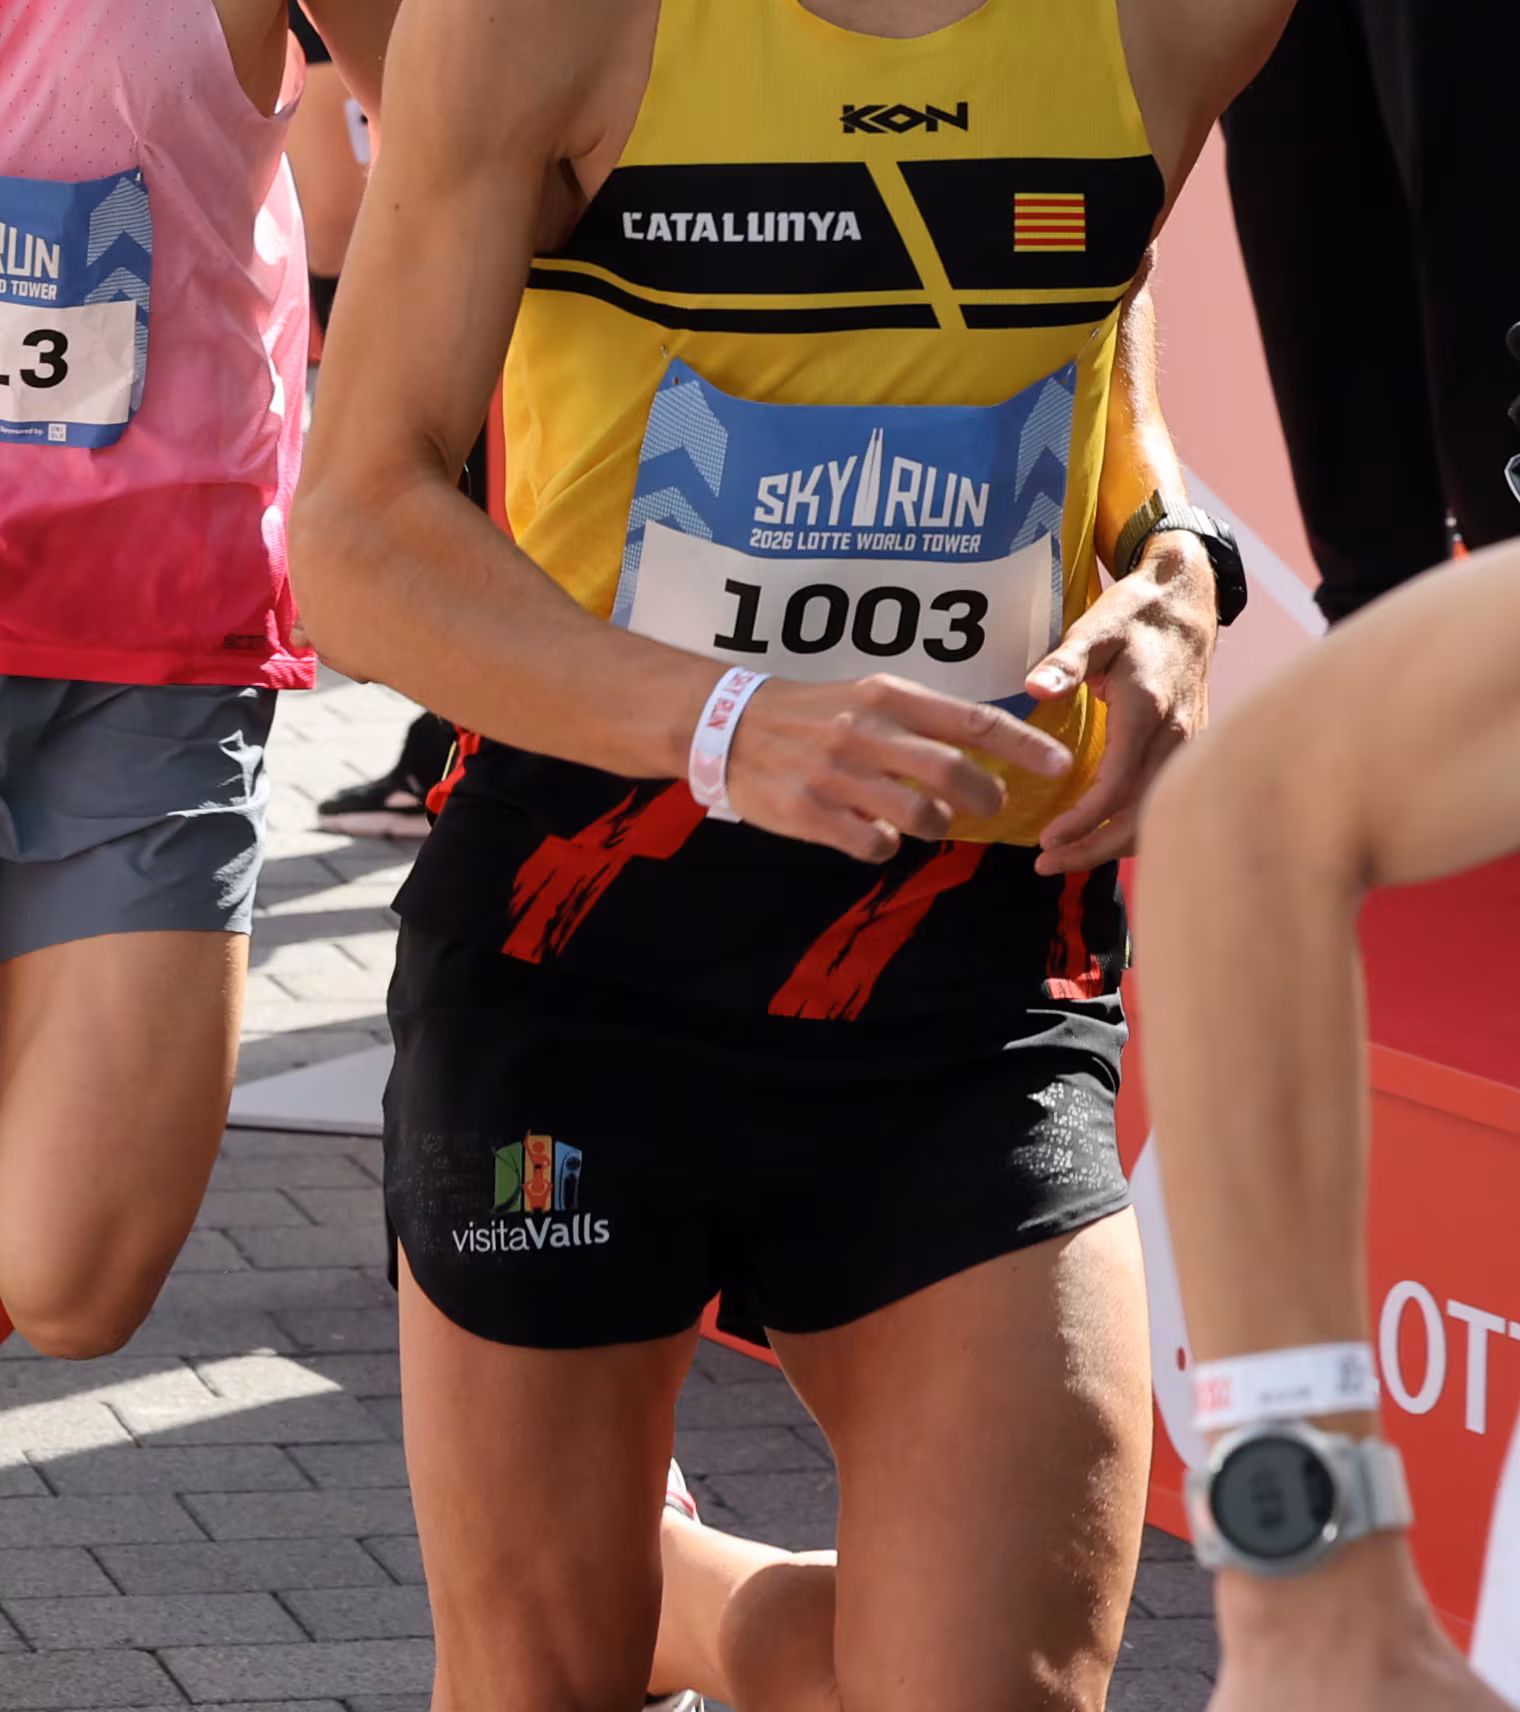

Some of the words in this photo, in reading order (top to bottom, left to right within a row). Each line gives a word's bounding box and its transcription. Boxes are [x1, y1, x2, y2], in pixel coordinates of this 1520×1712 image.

[840, 101, 969, 134] KON
[10, 279, 58, 300] TOWER
[753, 455, 858, 527] SKY
[883, 456, 990, 528] RUN
[749, 527, 793, 550] 2026
[797, 531, 852, 551] LOTTE
[856, 532, 917, 552] WORLD
[922, 533, 982, 554] TOWER
[713, 577, 989, 663] 1003
[705, 698, 737, 731] RUN
[452, 1212, 611, 1253] visitaValls
